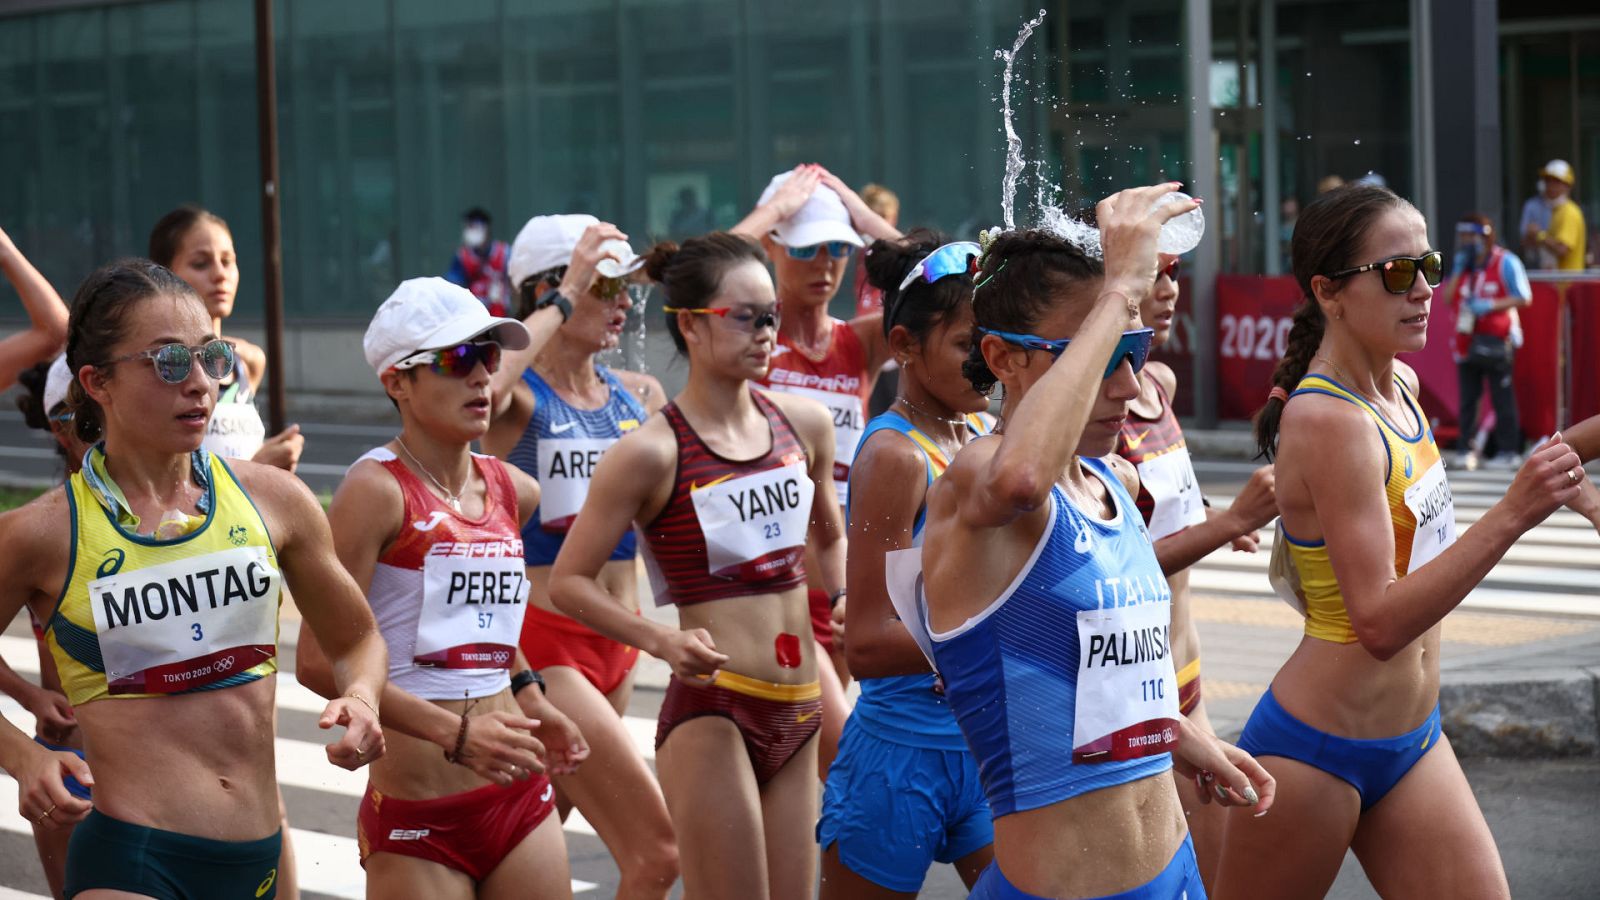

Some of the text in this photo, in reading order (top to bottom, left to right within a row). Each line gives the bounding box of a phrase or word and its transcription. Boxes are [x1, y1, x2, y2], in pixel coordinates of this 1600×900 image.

[1220, 314, 1294, 361] 2020
[548, 450, 606, 479] ARE
[728, 478, 800, 522] YANG
[763, 522, 782, 540] 23
[101, 561, 271, 630] MONTAG
[446, 571, 524, 605] PEREZ
[1095, 573, 1171, 611] ITALIA
[191, 622, 204, 642] 3
[478, 613, 494, 629] 57
[162, 665, 212, 684] TOKYO 2020
[1141, 678, 1165, 703] 110
[1129, 733, 1162, 748] TOKYO 2020
[388, 828, 431, 841] ESP
